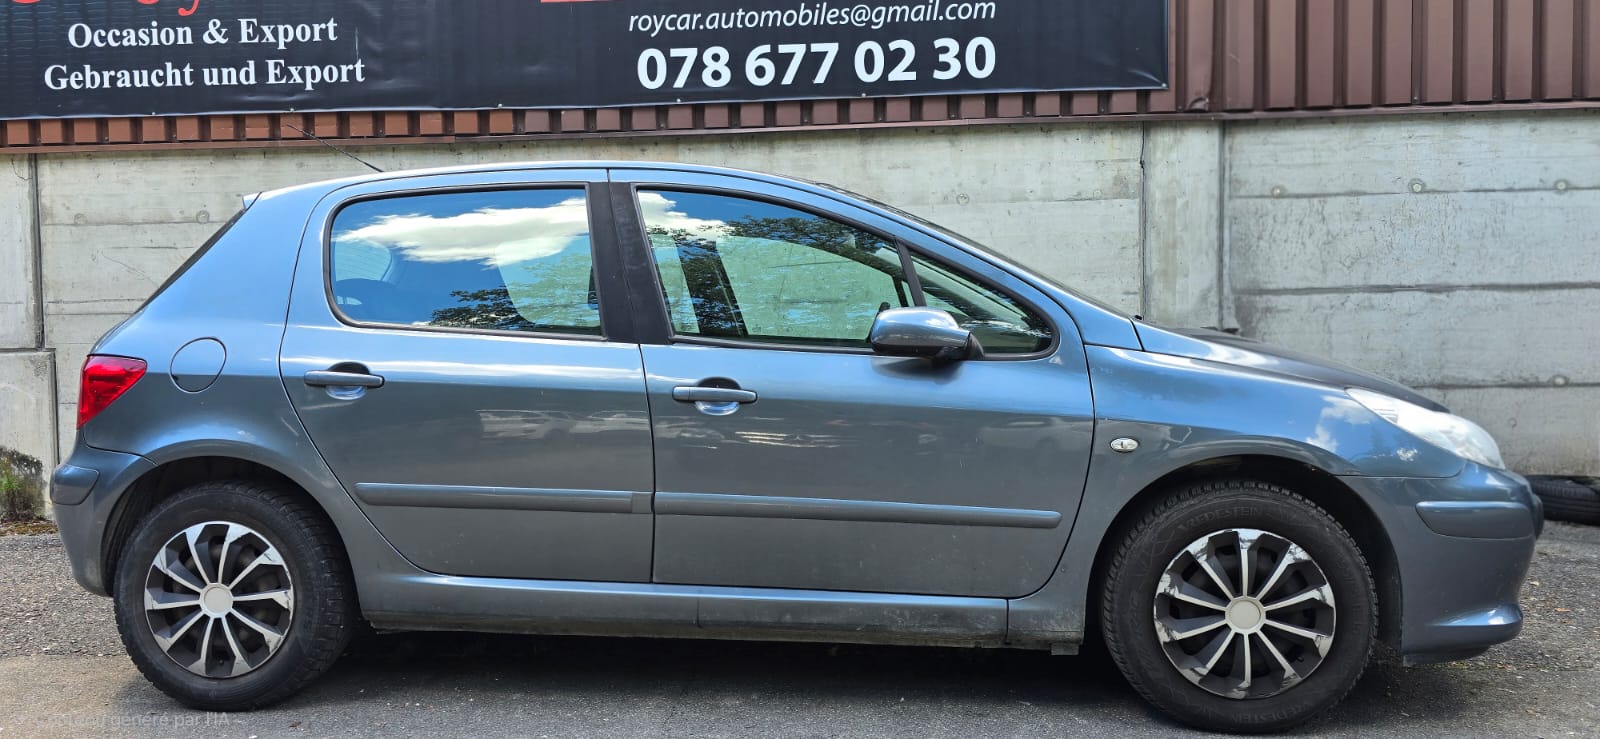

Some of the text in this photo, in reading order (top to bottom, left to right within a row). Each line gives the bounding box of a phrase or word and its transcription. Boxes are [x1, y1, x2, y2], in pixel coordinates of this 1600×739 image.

[68, 16, 338, 50] Occasion & Export
[628, 0, 996, 37] roycar.automobiles@gmail.com
[44, 58, 366, 91] Gebraucht und Export
[637, 36, 996, 90] 078 677 02 30
